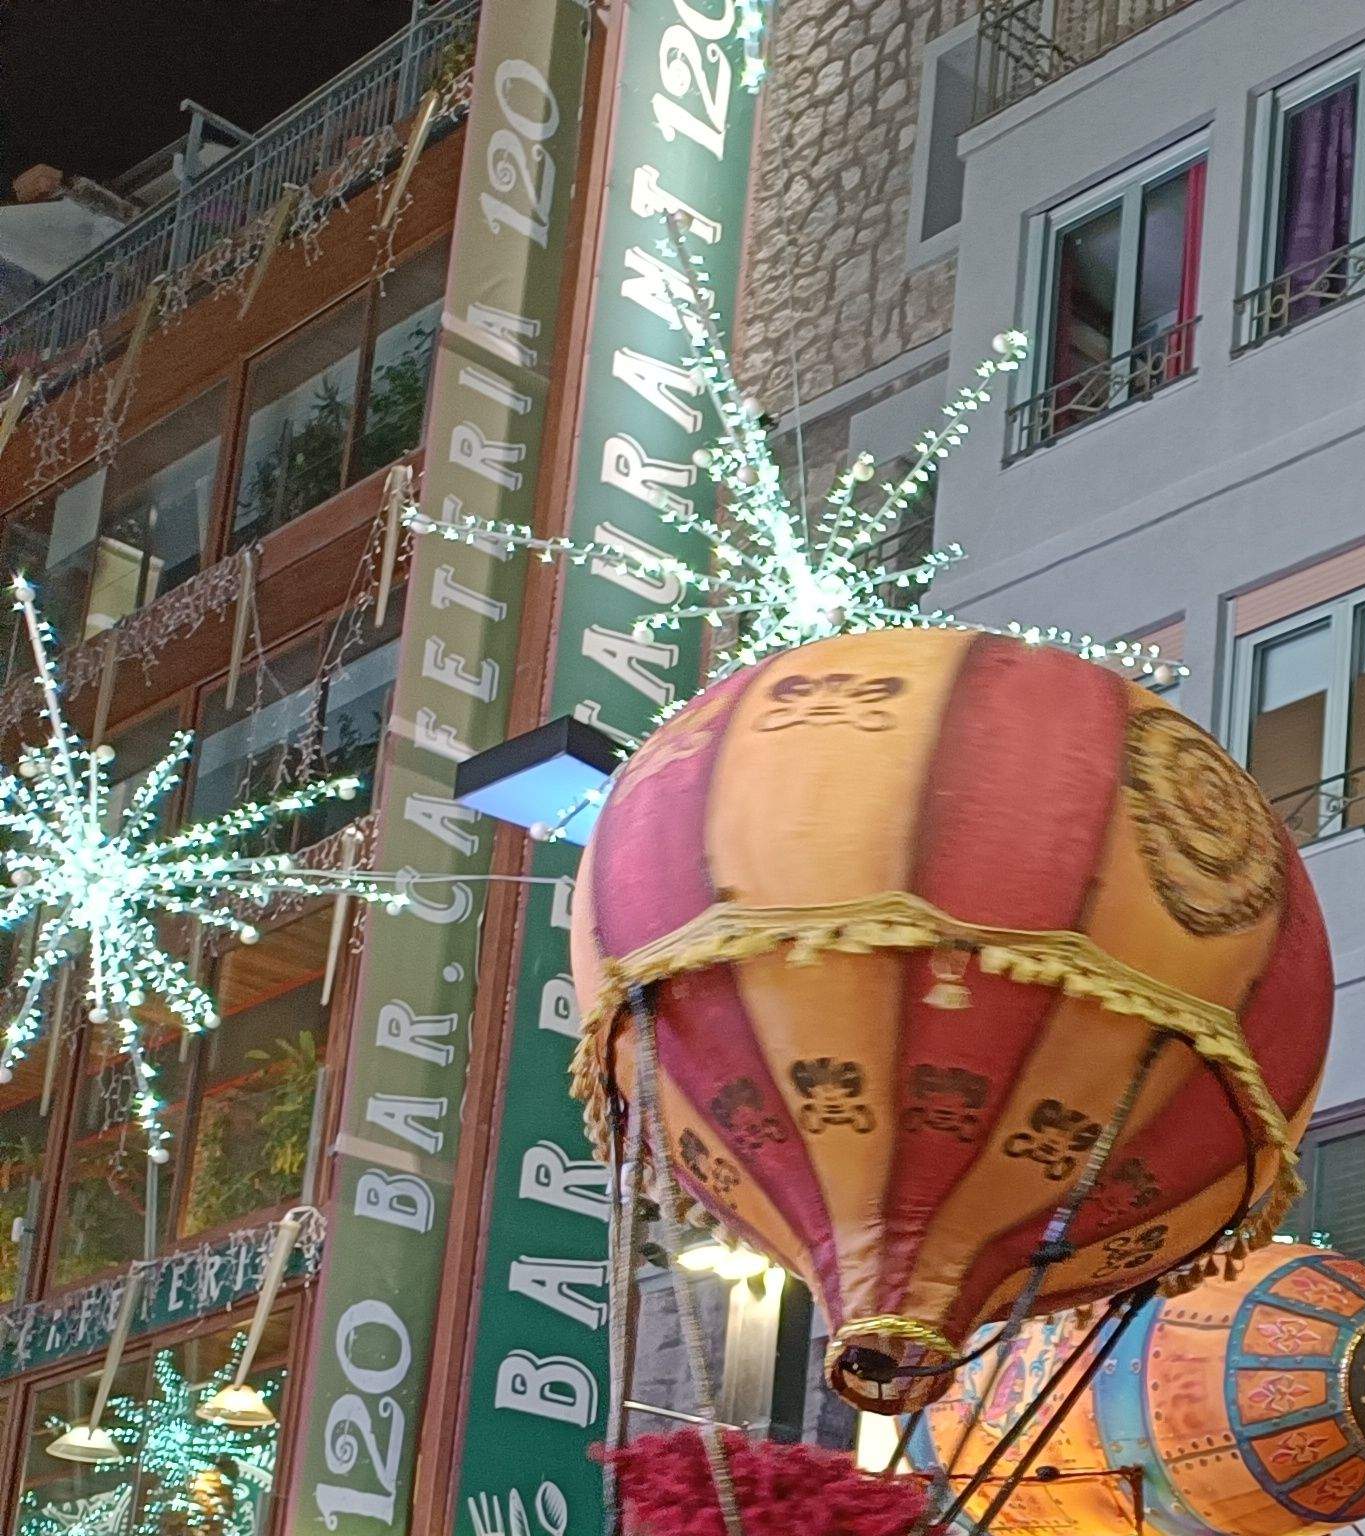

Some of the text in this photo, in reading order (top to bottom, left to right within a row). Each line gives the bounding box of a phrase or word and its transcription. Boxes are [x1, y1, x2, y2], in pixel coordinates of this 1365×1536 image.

[315, 1299, 412, 1531] 120
[404, 302, 542, 925] CAFETERIA
[479, 58, 561, 249] 120
[494, 1140, 611, 1428] BAR
